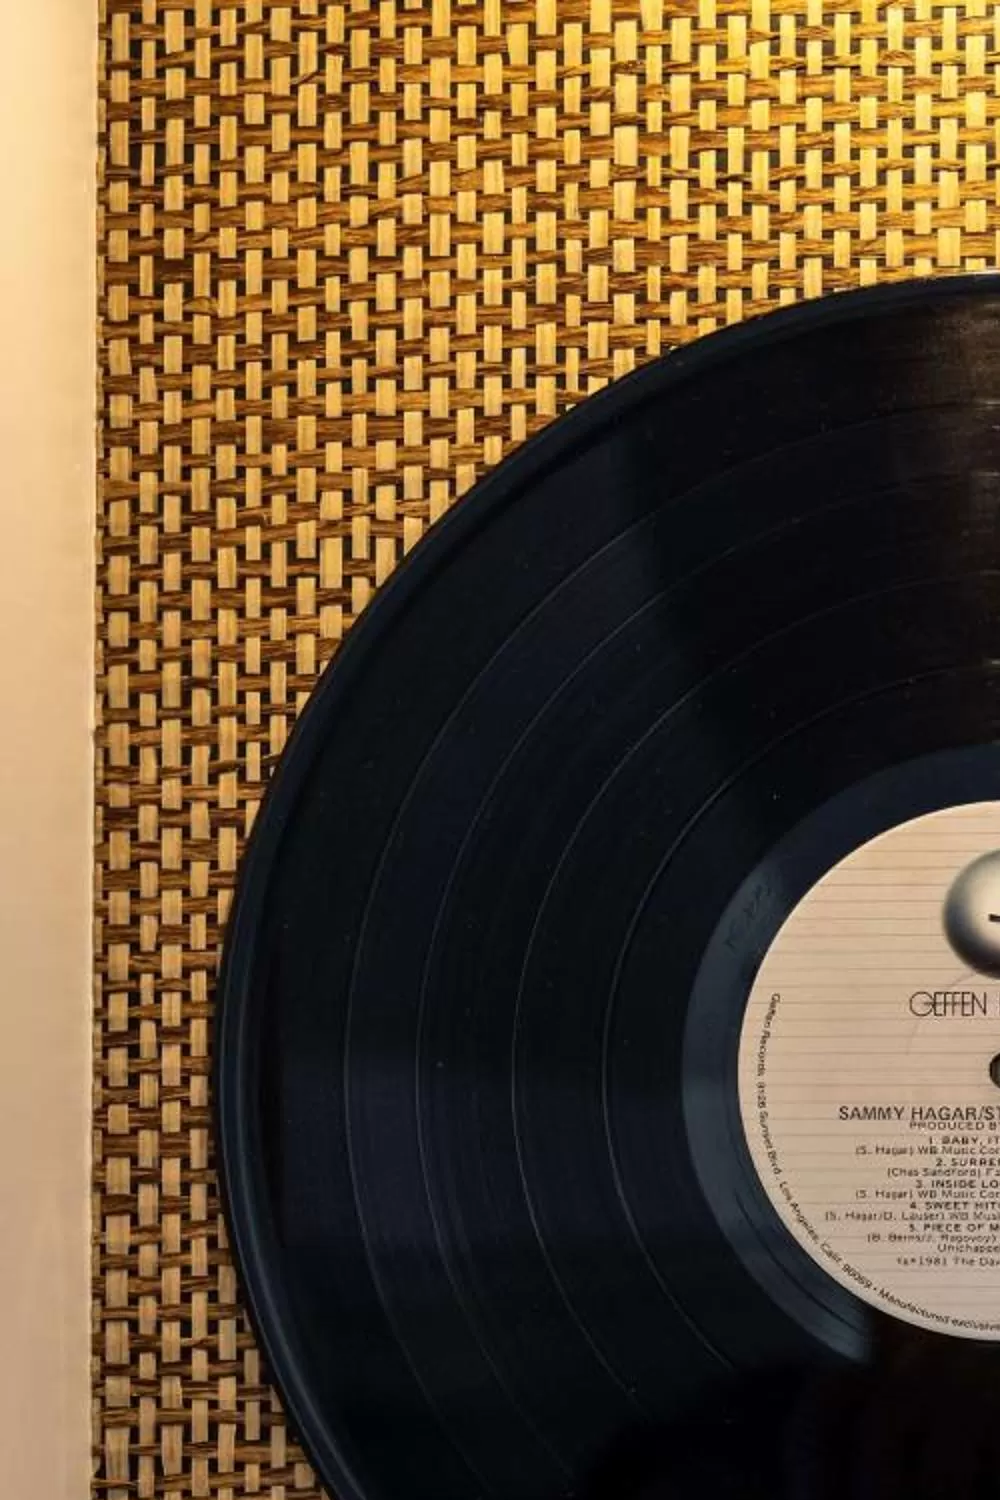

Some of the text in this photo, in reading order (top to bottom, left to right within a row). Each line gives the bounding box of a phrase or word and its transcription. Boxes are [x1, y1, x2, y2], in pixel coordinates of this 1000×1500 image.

[909, 989, 987, 1018] GEFFEN
[838, 1105, 905, 1121] SAMMY
[909, 1121, 985, 1131] PRODUCED
[931, 1179, 977, 1189] INSIDE
[924, 1201, 969, 1210] SWEET
[923, 1223, 962, 1233] PIECE
[966, 1223, 984, 1233] OF
